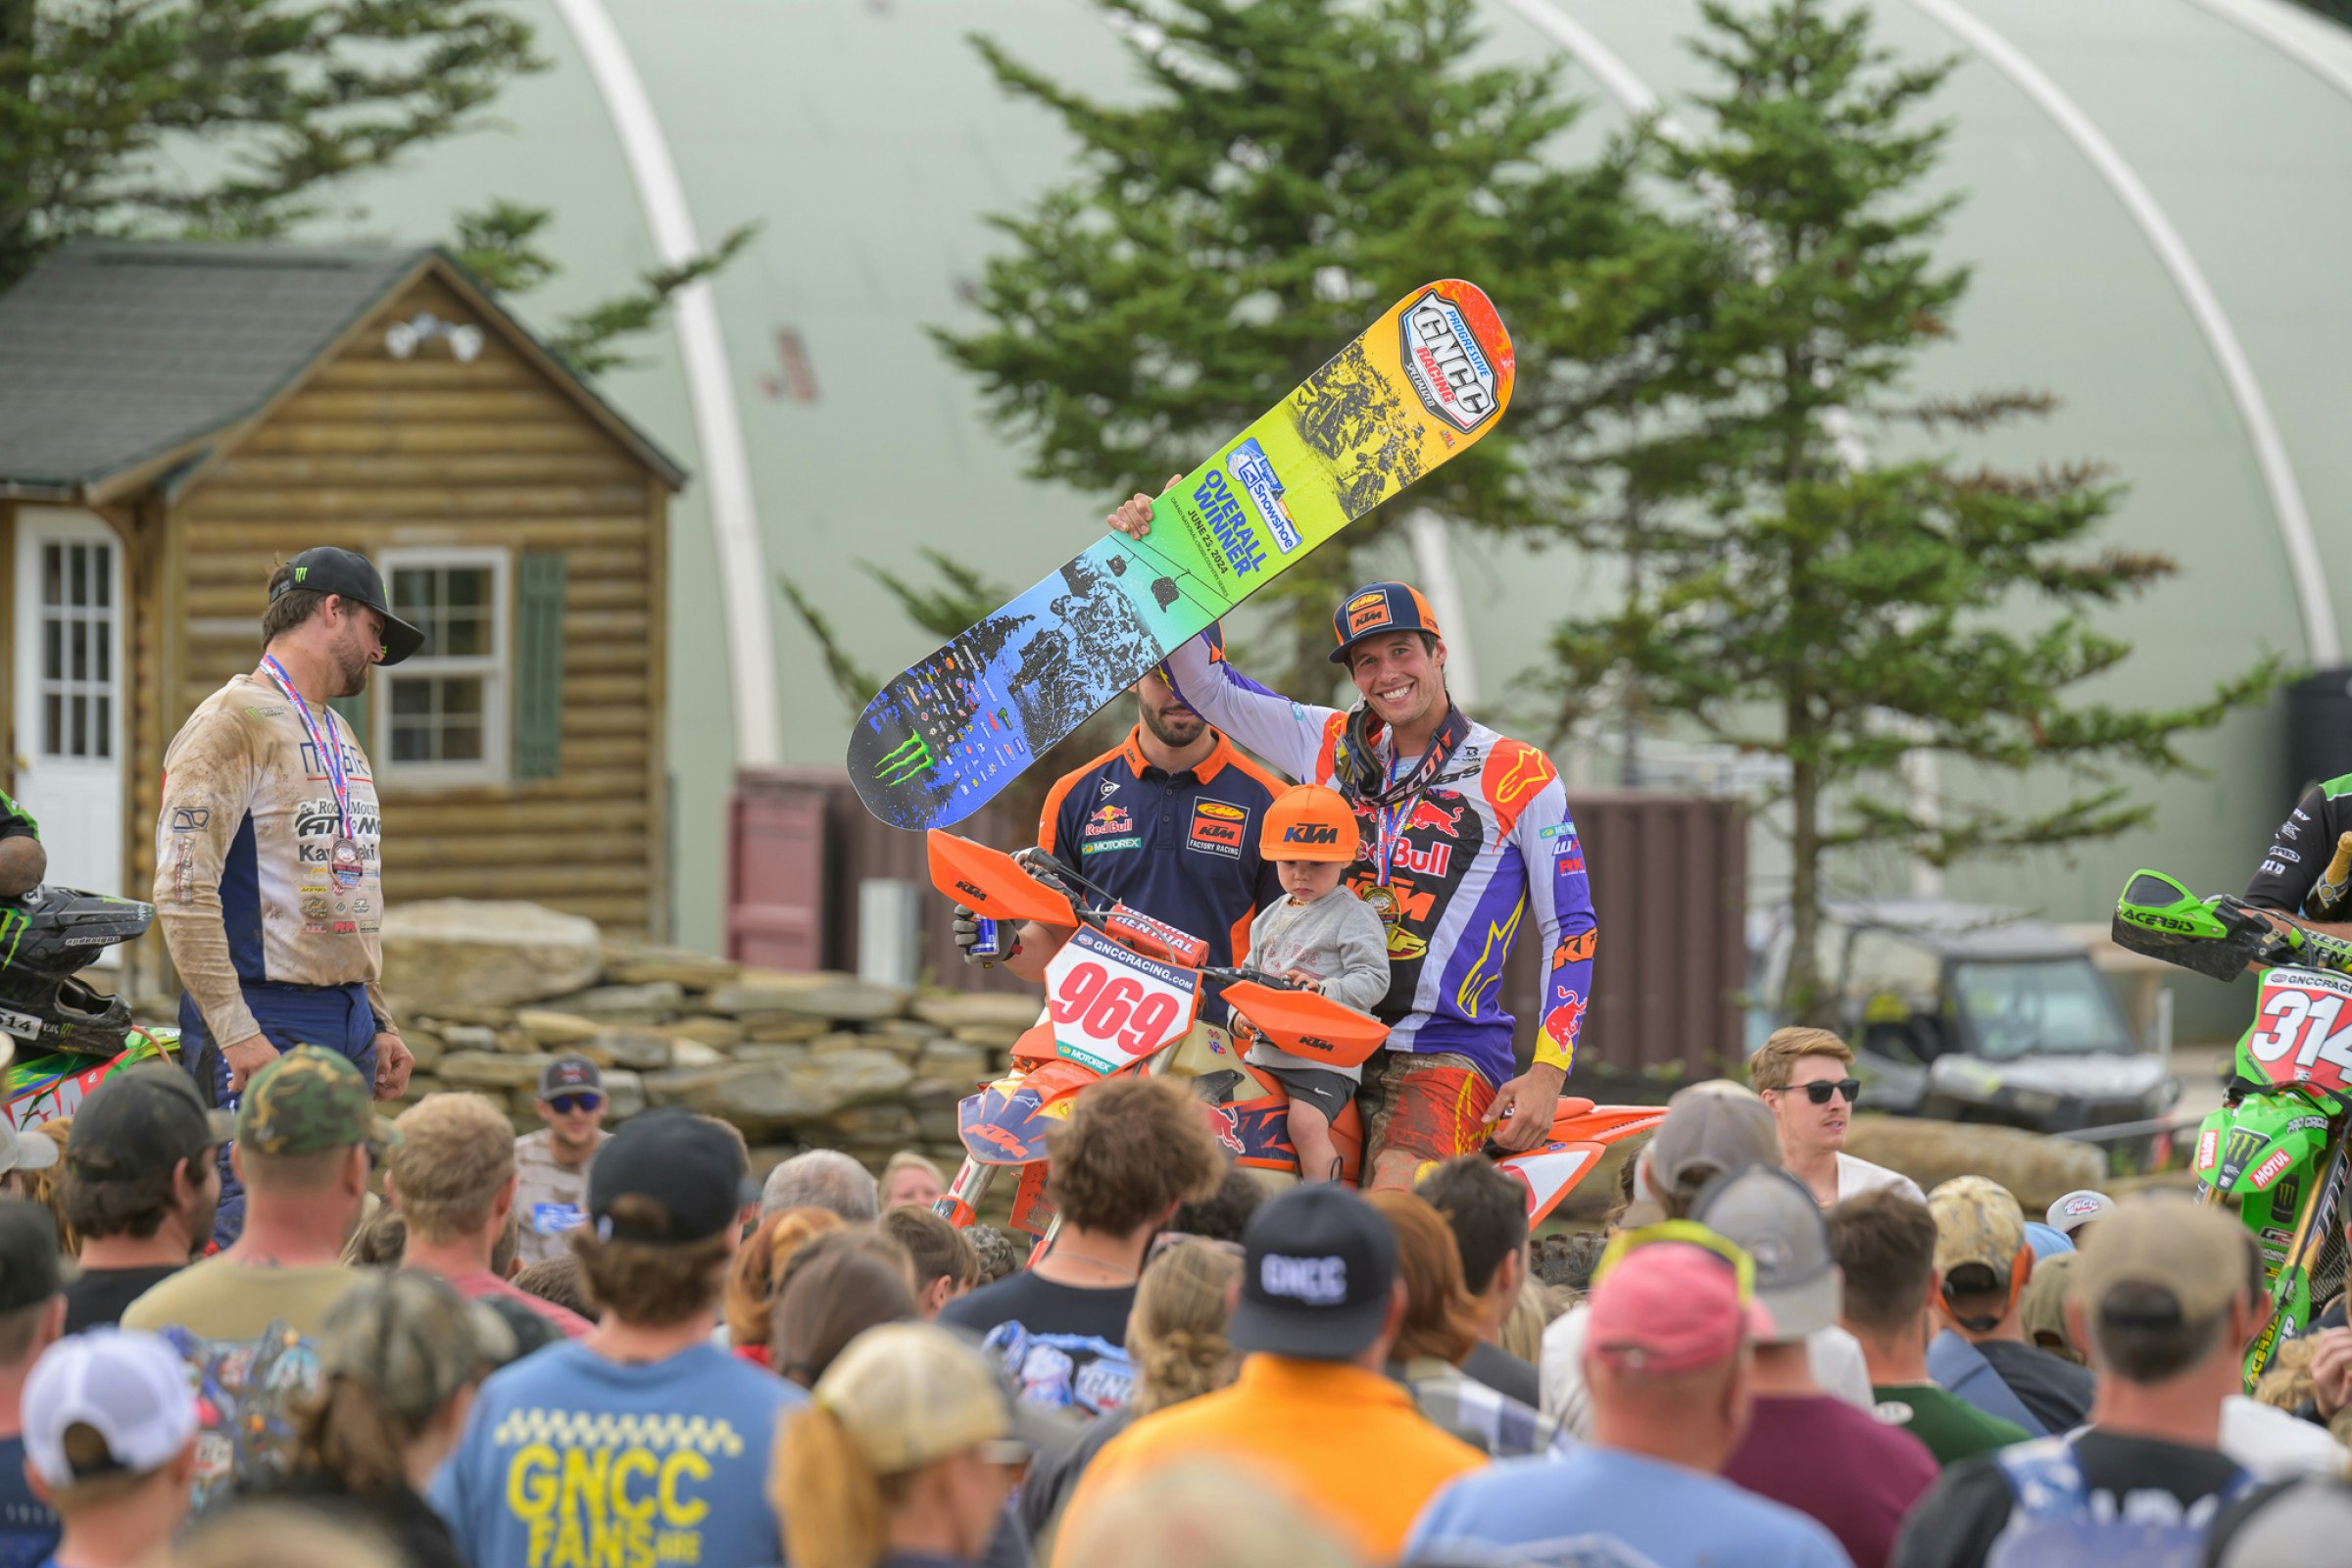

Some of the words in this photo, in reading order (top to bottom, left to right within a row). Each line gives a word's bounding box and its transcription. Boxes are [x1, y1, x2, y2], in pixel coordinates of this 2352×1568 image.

[1413, 307, 1490, 414] GNCC
[1446, 311, 1491, 377] PROGRESSIVE
[1405, 364, 1436, 407] SPECIALIZED
[1416, 347, 1455, 404] RACING
[1194, 482, 1251, 578] WINNER
[1205, 469, 1266, 572] OVERALL
[1254, 483, 1293, 548] Snowshoe
[1188, 510, 1206, 536] JUNE
[1202, 534, 1214, 551] 23,
[1210, 549, 1228, 574] 2024
[1355, 611, 1382, 627] KTM
[1085, 821, 1108, 836] Red
[1109, 818, 1133, 833] Bull
[1094, 839, 1140, 851] MOTOREX
[1190, 839, 1215, 851] FACTORY
[1216, 844, 1240, 856] RACING
[1199, 824, 1235, 840] KTM
[1284, 822, 1338, 844] KTM
[1392, 837, 1452, 878] Bull
[955, 880, 987, 902] KTM
[1093, 940, 1194, 991] GNCCRACING.COM
[1050, 961, 1180, 1055] 969
[1071, 1049, 1111, 1072] MOTOREX
[1298, 1035, 1334, 1052] KTM
[963, 1123, 1029, 1159] KTM
[2200, 1131, 2217, 1169] MOTUL
[2253, 1151, 2288, 1188] MOTUL
[507, 1443, 711, 1528] GNCC
[526, 1517, 657, 1568] FANS
